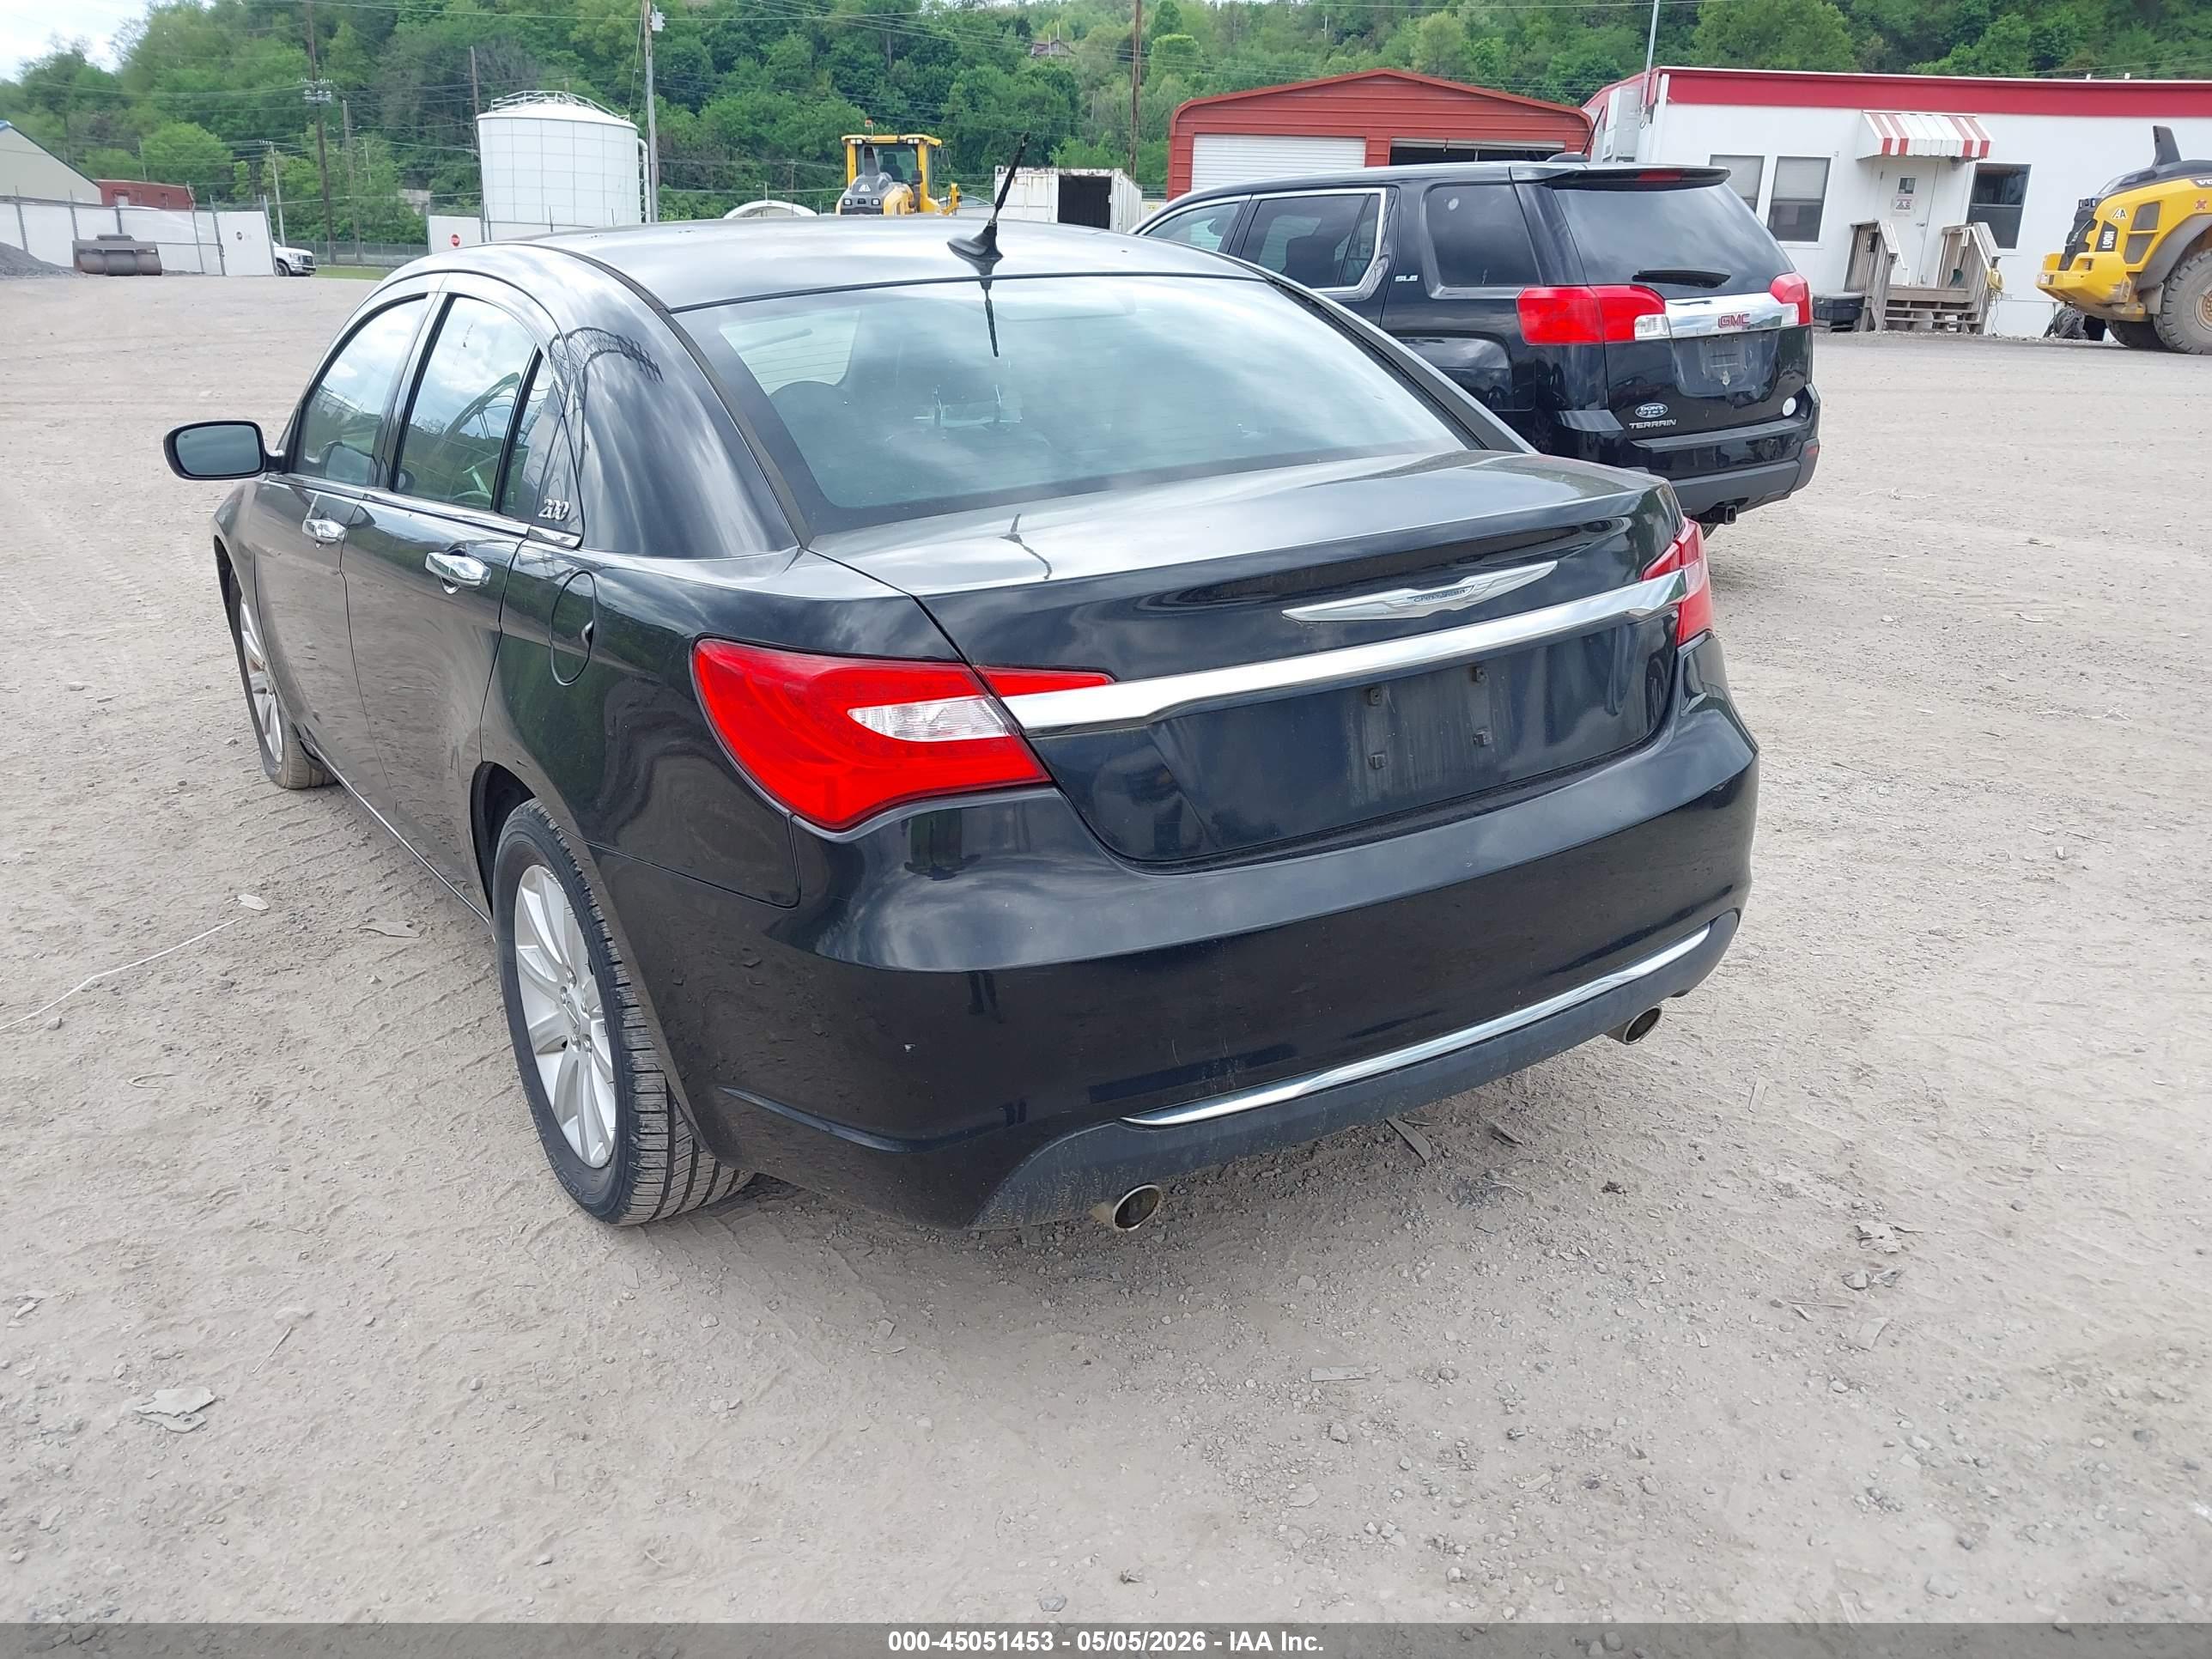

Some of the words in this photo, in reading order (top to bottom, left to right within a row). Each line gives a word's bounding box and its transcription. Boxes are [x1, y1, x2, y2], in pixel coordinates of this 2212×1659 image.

[2102, 231, 2115, 248] L90H
[1718, 313, 1751, 329] GMC
[1628, 418, 1677, 429] TERRAIN
[538, 499, 570, 520] 200
